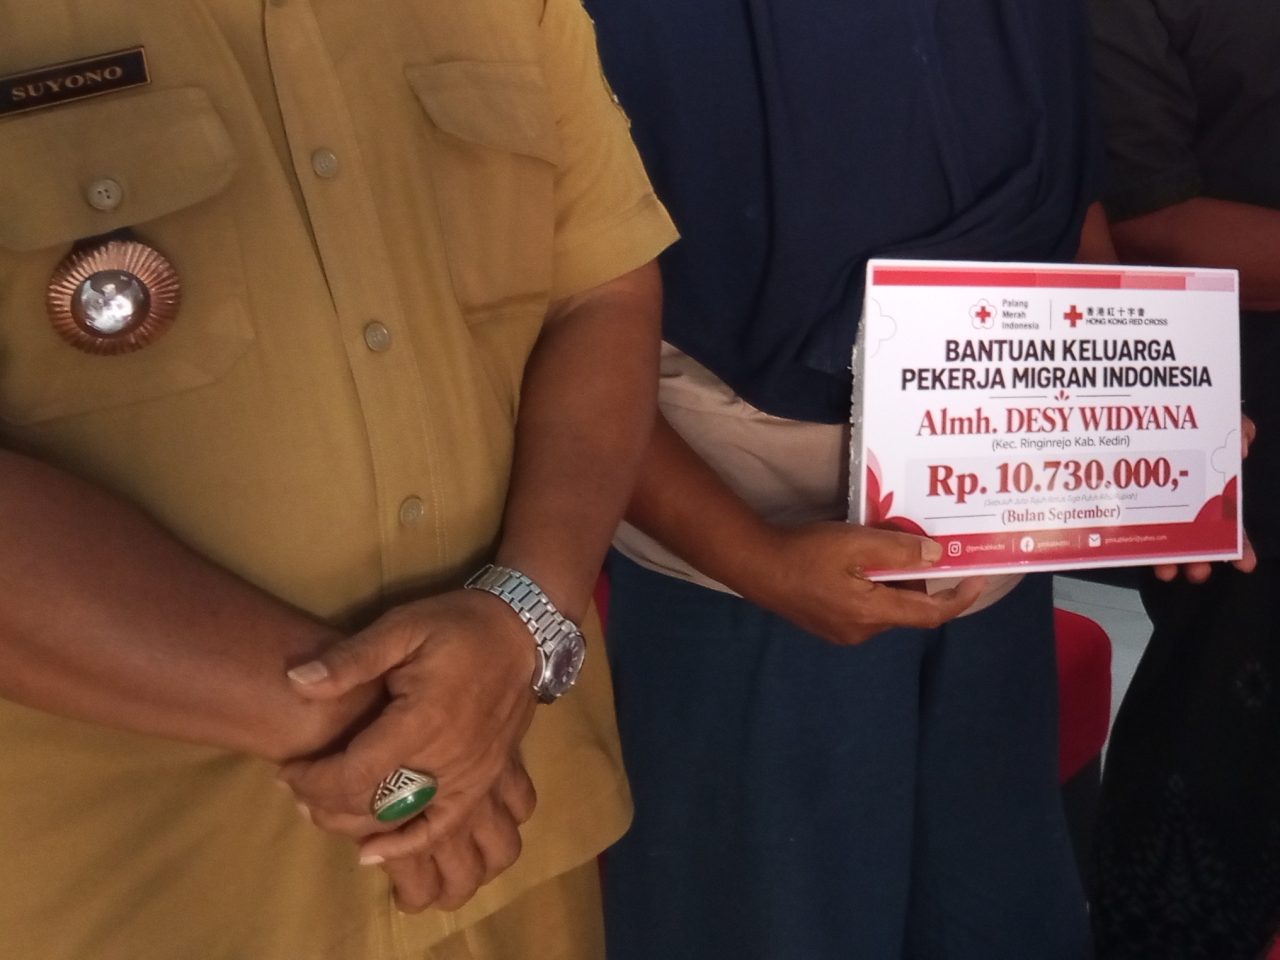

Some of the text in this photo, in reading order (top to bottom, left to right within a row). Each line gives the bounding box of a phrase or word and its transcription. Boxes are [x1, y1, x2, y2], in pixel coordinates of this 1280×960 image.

[11, 65, 123, 101] SUYONO
[1002, 299, 1028, 309] Palang
[1002, 310, 1026, 319] Merah
[1002, 321, 1039, 330] Indonesia
[945, 339, 1176, 362] BANTUAN KELUARGA
[901, 366, 1212, 390] PEKERJA MIGRAN INDONESIA
[917, 405, 1199, 436] Almh. DESY WIDYANA
[992, 435, 1130, 451] (Kec. Ringinrejo Kab. Kediri)
[926, 457, 1189, 503] Rp. 10.730.000,-
[1001, 505, 1121, 525] (Bulan September)
